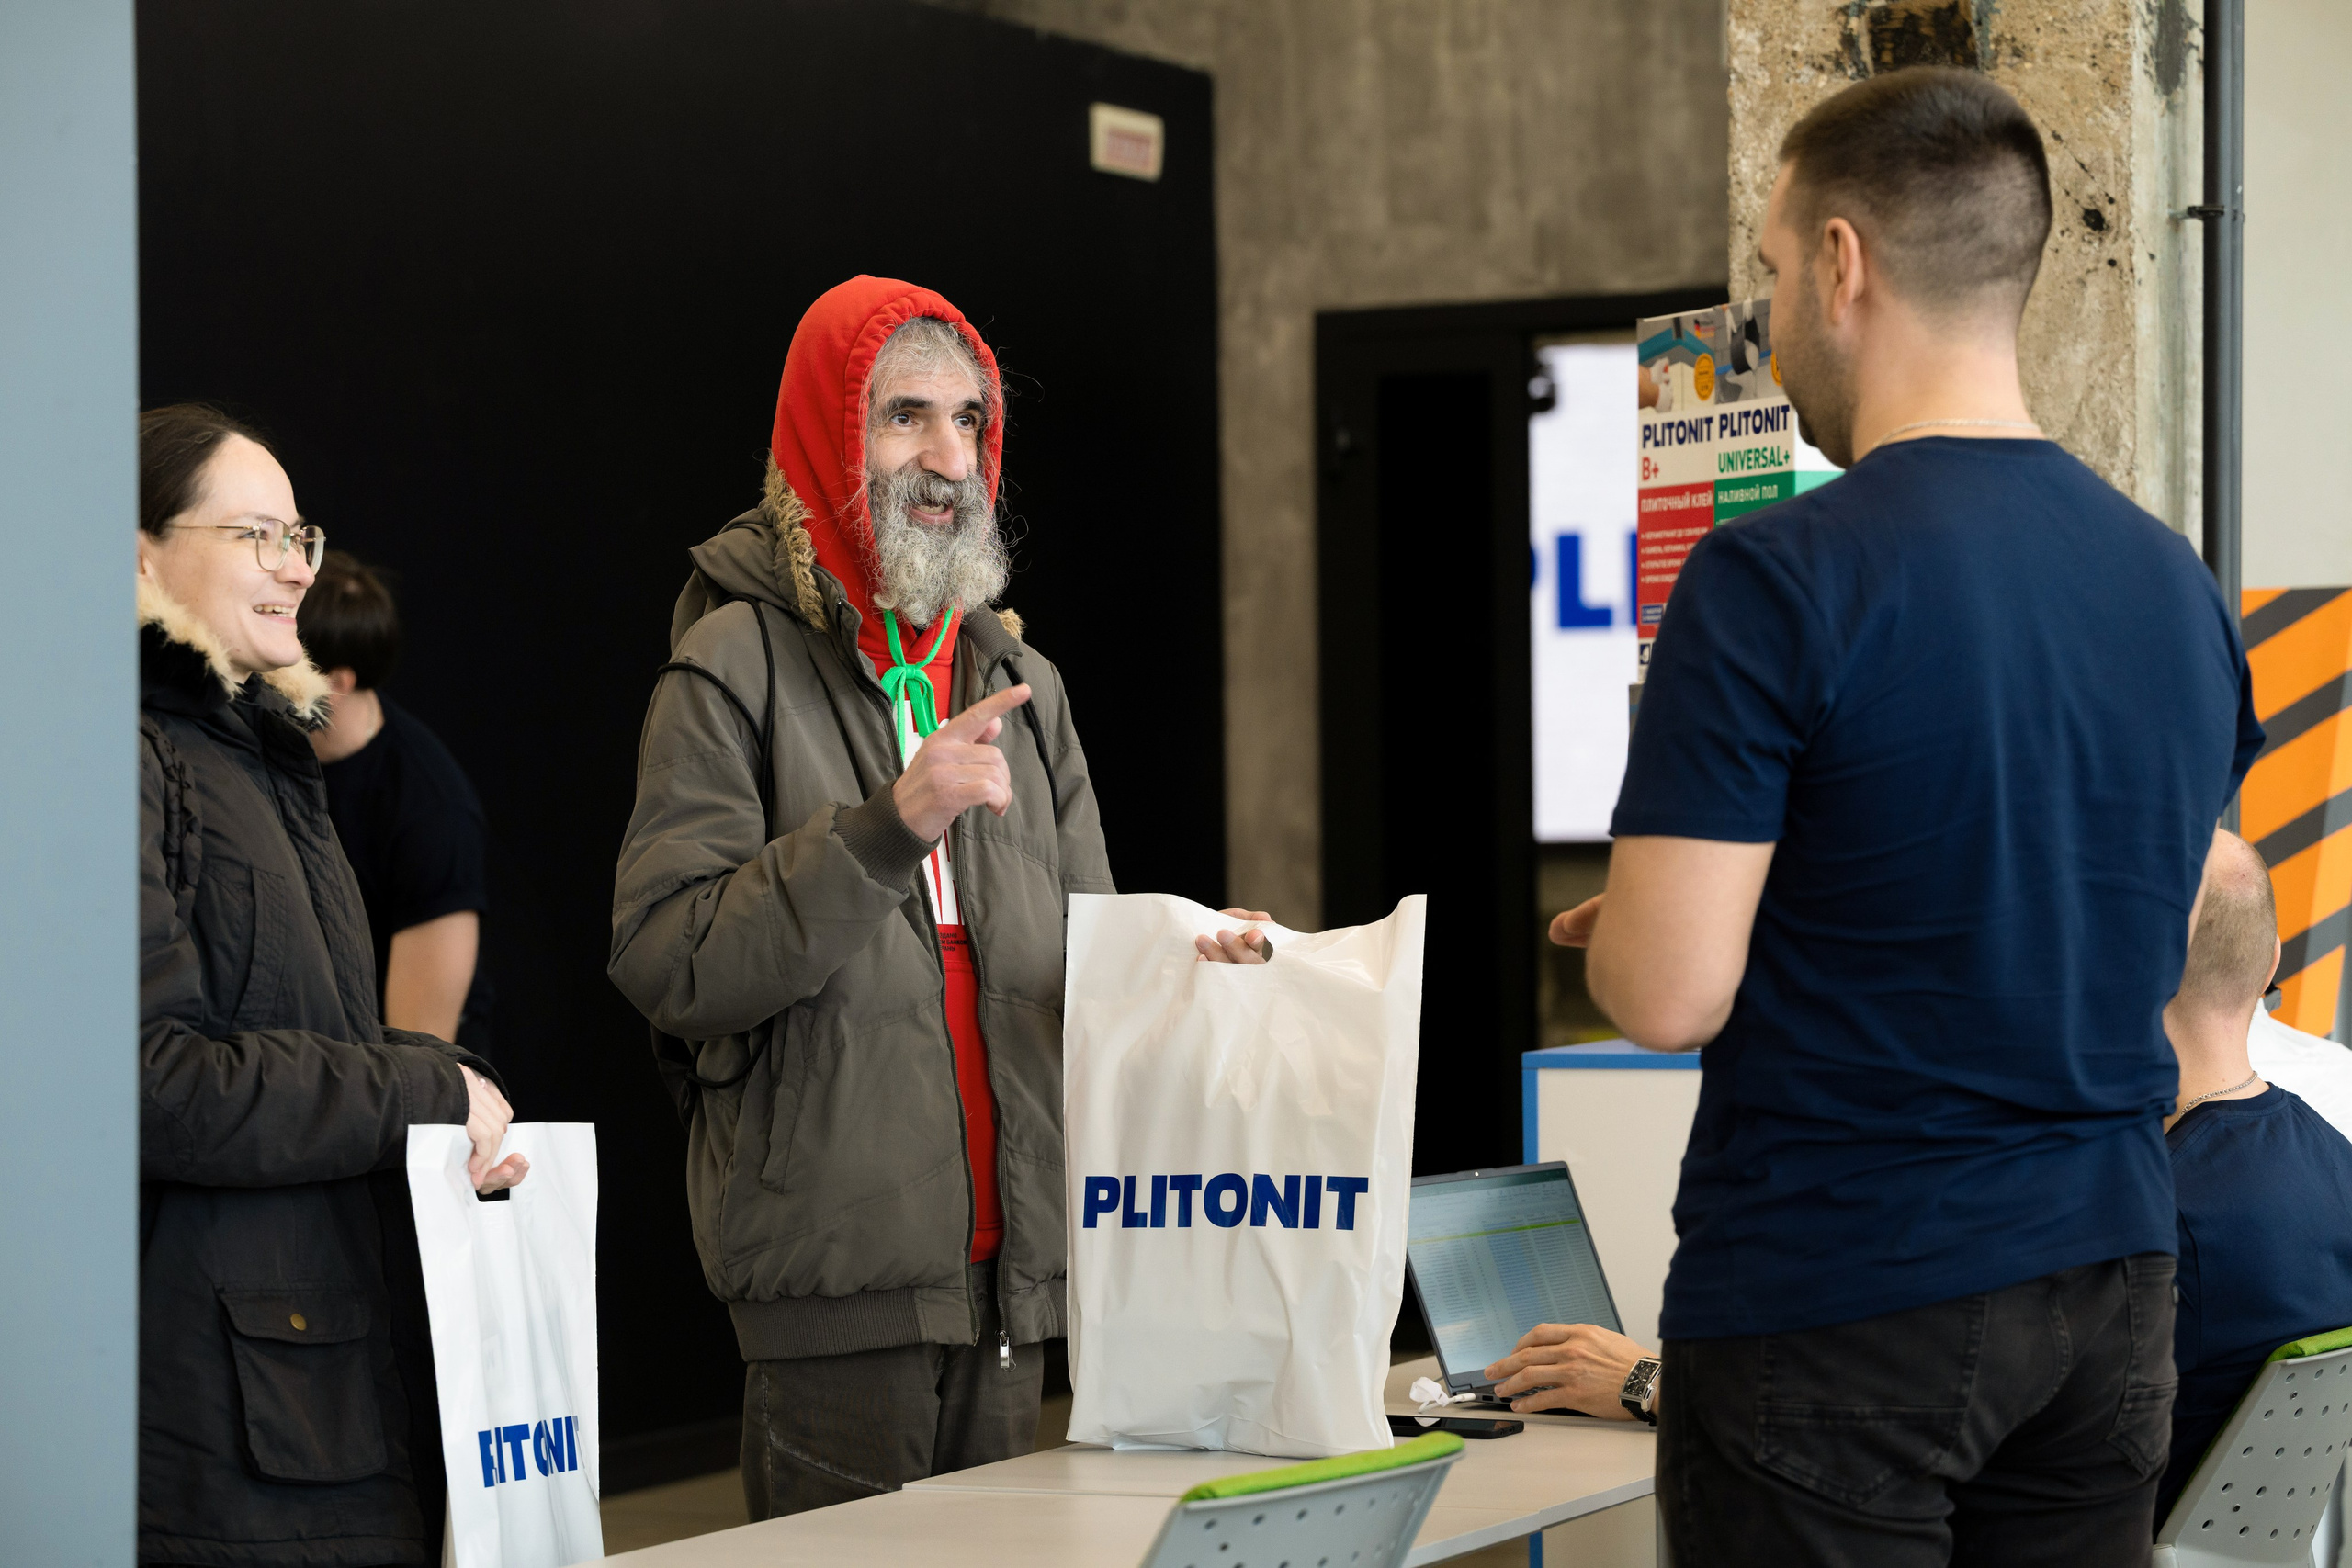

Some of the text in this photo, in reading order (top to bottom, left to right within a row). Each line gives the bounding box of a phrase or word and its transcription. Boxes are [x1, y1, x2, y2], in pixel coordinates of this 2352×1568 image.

[1643, 416, 1713, 449] PLITONIT
[1719, 404, 1790, 439] PLITONIT
[1642, 457, 1659, 481] B+
[1718, 446, 1791, 474] UNIVERSAL+
[1641, 490, 1713, 513] ПЛИТОЧНЫЙ КЛЕЙ
[1717, 484, 1779, 504] НАЛИВНОЙ ПОЛ
[1082, 1172, 1369, 1231] PLITONIT
